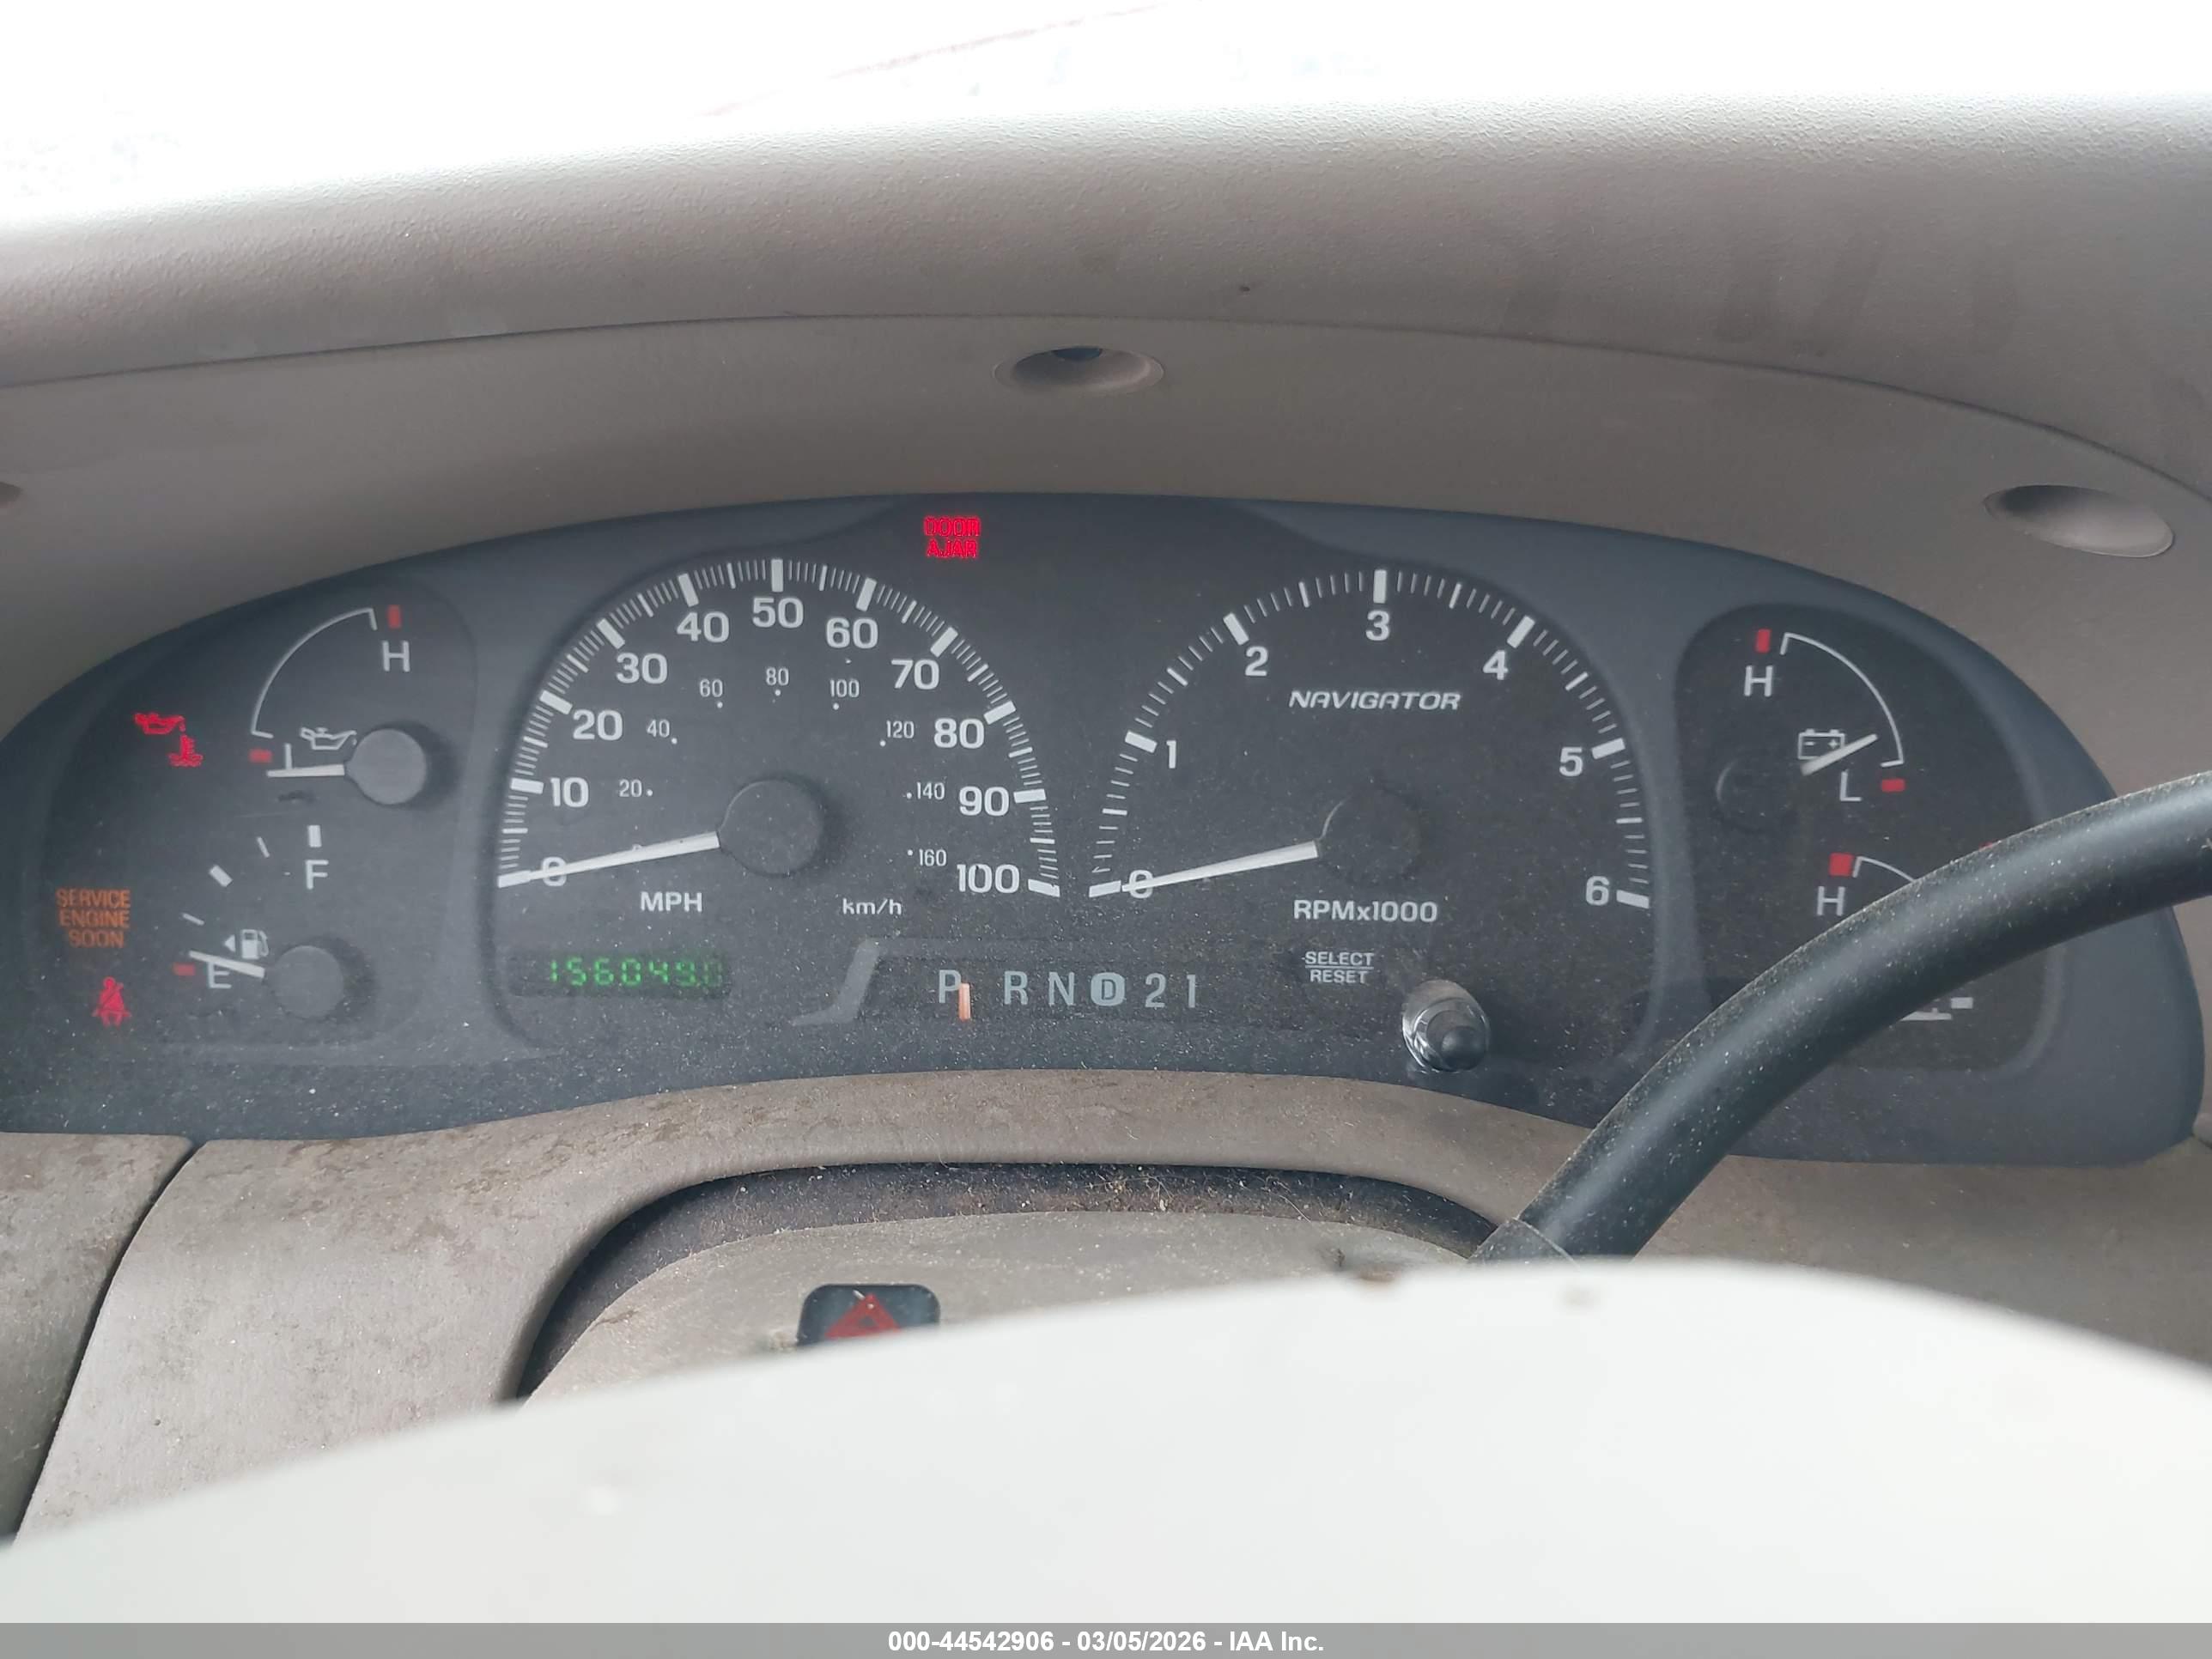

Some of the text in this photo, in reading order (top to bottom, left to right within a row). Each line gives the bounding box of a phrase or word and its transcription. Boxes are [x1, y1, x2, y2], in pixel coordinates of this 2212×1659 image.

[924, 516, 981, 537] DOOR
[927, 538, 978, 558] AJAR
[676, 611, 730, 643] 40
[752, 597, 804, 629] 50
[1365, 610, 1390, 641] 3
[826, 617, 878, 649] 60
[382, 641, 410, 672] H
[616, 652, 668, 684] 30
[1244, 646, 1268, 677] 2
[1482, 649, 1509, 681] 4
[699, 678, 723, 697] 60
[765, 667, 789, 686] 80
[830, 678, 860, 698] 100
[890, 659, 939, 690] 70
[1743, 665, 1773, 697] H
[1289, 690, 1462, 710] NAVIGATOR
[573, 709, 623, 741] 20
[647, 719, 670, 738] 40
[886, 720, 915, 738] 120
[933, 718, 985, 749] 80
[1166, 739, 1177, 769] 1
[1559, 746, 1583, 777] 5
[550, 777, 589, 808] 10
[619, 779, 642, 798] 20
[916, 781, 945, 800] 140
[958, 786, 1010, 817] 90
[1839, 771, 1862, 802] L
[542, 856, 567, 886] 0
[919, 848, 947, 866] 160
[305, 859, 329, 890] F
[957, 863, 1020, 894] 100
[1129, 870, 1153, 898] 0
[56, 889, 131, 908] SERVICE
[640, 890, 702, 913] MPH
[1585, 875, 1610, 906] 6
[1816, 885, 1845, 916] H
[59, 908, 130, 928] ENGINE
[842, 897, 902, 915] km/h
[1293, 899, 1437, 922] RPMx1000
[69, 929, 124, 948] SOON
[208, 959, 232, 988] E
[1305, 951, 1374, 966] SELECT
[939, 969, 961, 1003] P
[1004, 971, 1028, 1005] R
[1048, 972, 1074, 1006] N
[1145, 973, 1166, 1008] 2
[1187, 975, 1196, 1008] 1
[1310, 969, 1368, 983] RESET
